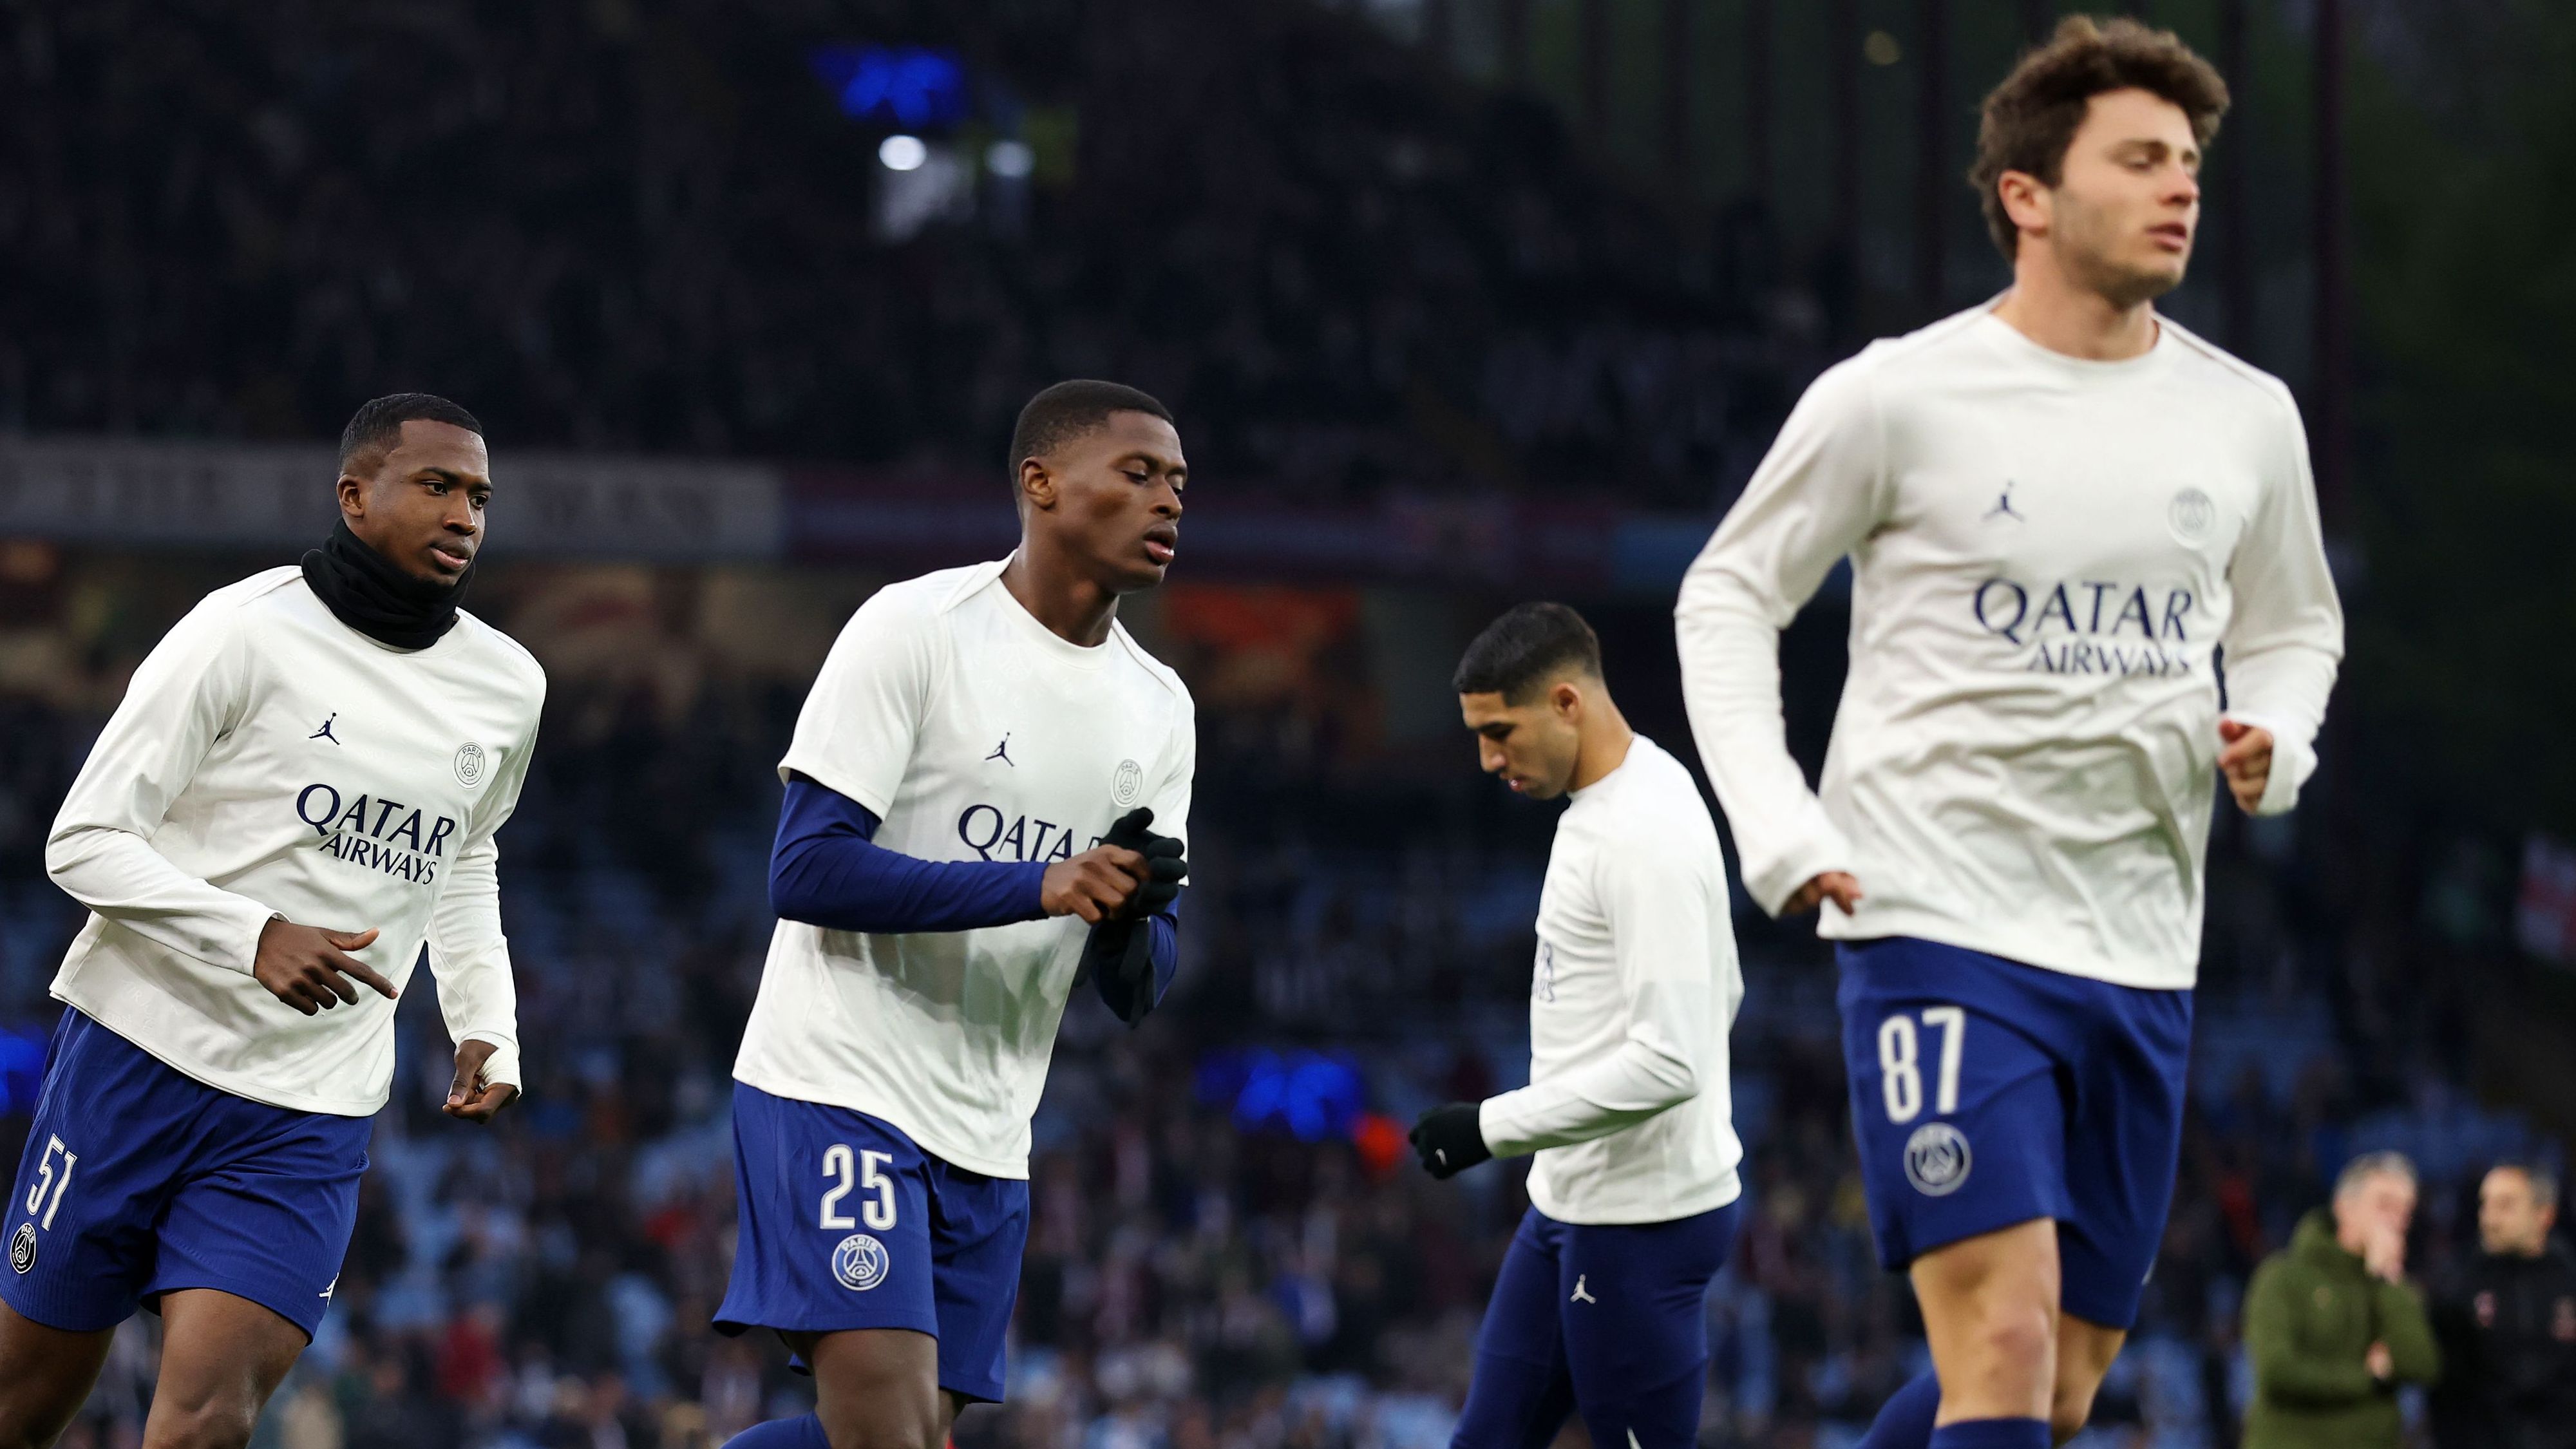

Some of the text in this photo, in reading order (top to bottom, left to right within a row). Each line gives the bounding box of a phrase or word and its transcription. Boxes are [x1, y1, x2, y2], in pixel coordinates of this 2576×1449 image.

[1974, 577, 2191, 645] QATAR
[462, 747, 482, 758] PARIS
[297, 784, 455, 857] QATAR
[319, 835, 437, 885] AIRWAYS
[1878, 1007, 1964, 1124] 87
[26, 1133, 77, 1231] 51
[820, 1144, 896, 1230] 25
[841, 1238, 878, 1251] PARIS
